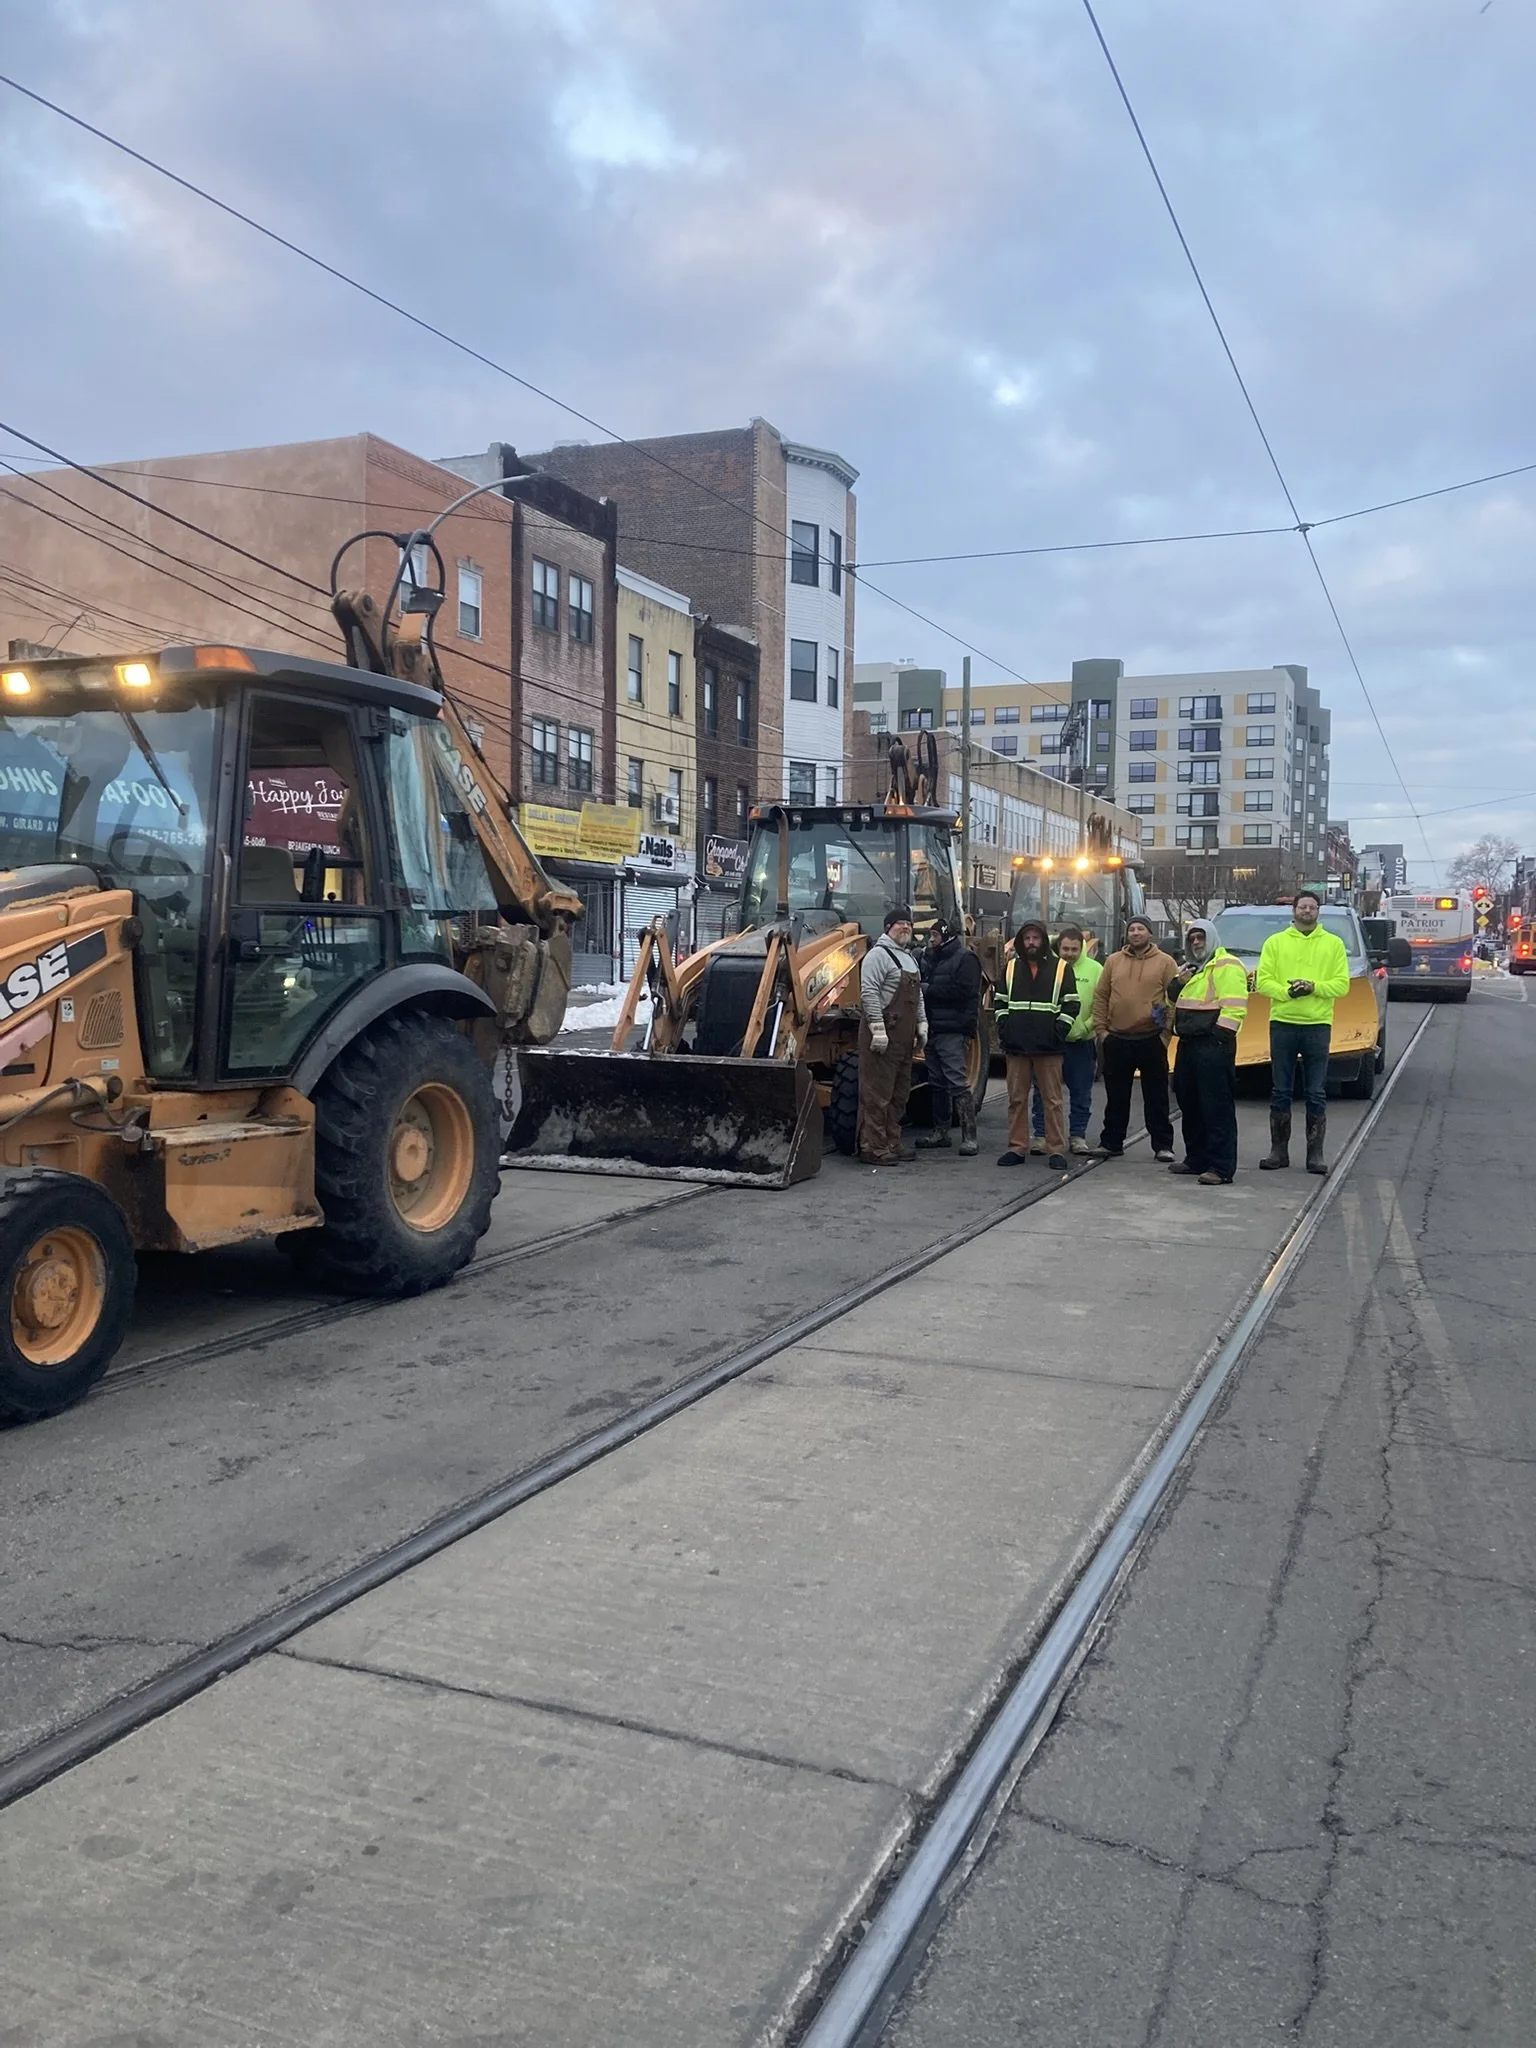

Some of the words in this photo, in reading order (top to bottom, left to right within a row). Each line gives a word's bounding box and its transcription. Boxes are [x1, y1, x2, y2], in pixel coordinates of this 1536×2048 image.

[0, 766, 58, 796] OHNS
[434, 722, 487, 814] CASE
[248, 780, 313, 814] Happy
[13, 817, 43, 832] GIRARD
[706, 839, 738, 863] Chopped
[1401, 919, 1446, 928] PATRIOT
